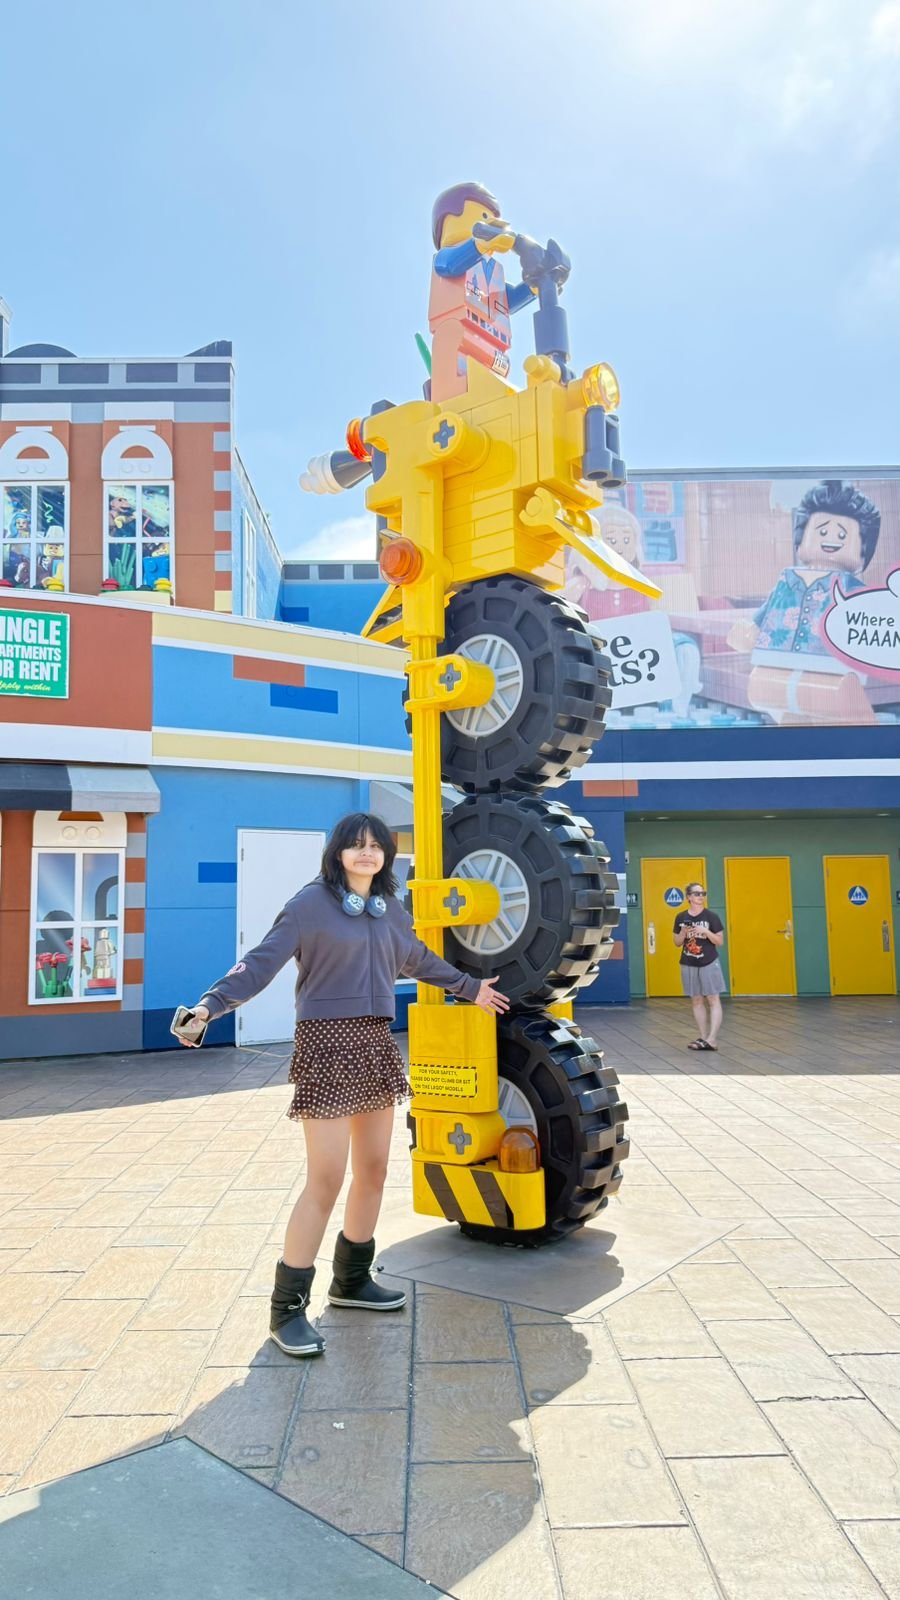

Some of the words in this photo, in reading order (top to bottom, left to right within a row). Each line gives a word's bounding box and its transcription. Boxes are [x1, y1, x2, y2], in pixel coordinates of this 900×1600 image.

[846, 610, 895, 627] Where
[0, 658, 14, 679] R
[19, 660, 61, 682] RENT
[24, 683, 51, 691] within
